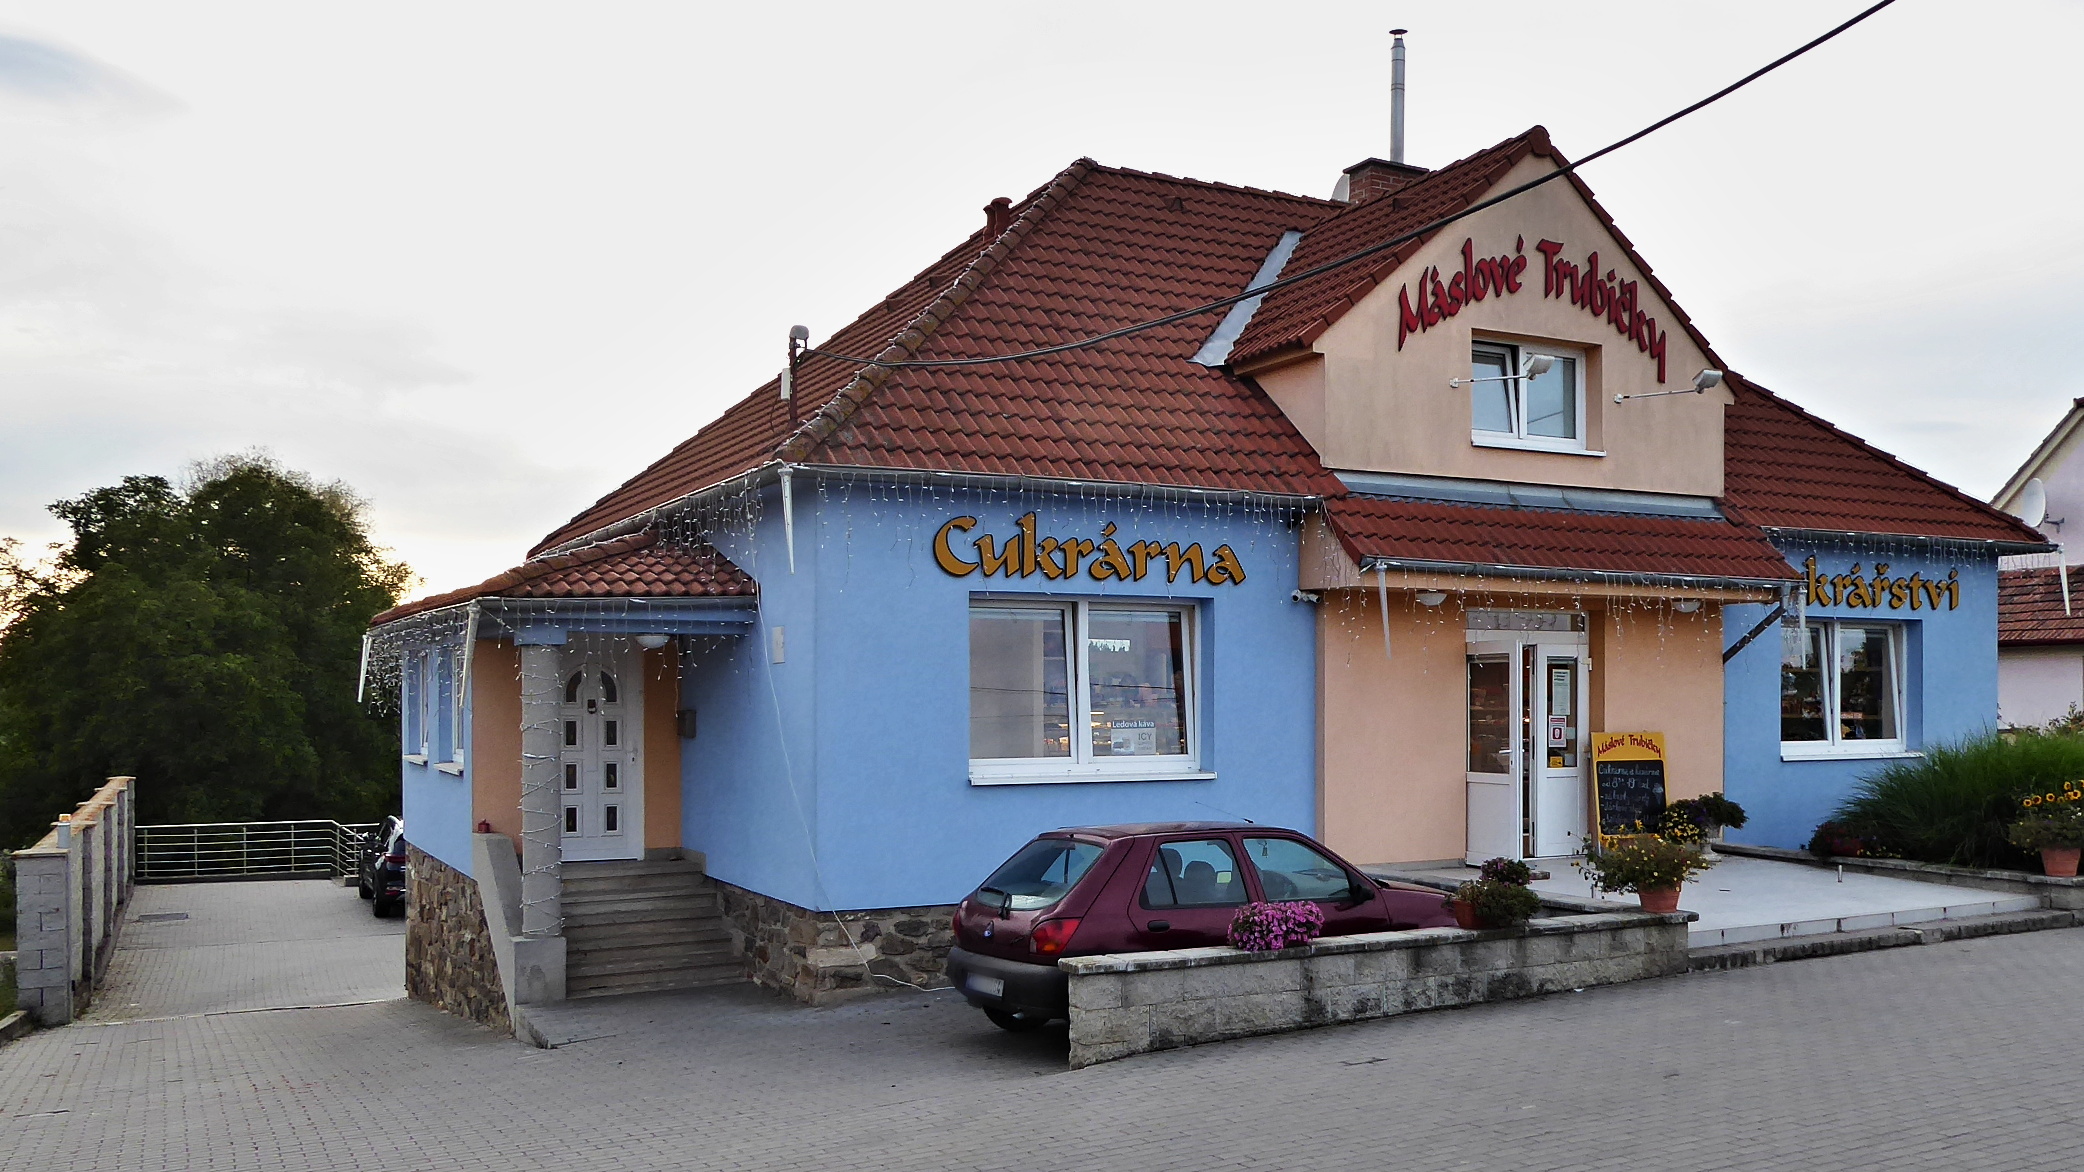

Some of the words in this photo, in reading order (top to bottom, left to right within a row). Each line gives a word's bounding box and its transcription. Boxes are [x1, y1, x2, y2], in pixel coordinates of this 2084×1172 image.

[1398, 234, 1527, 352] Máslové
[1536, 238, 1667, 384] Trubičky
[933, 511, 1247, 586] Cukrárna
[1801, 554, 1960, 611] krářství
